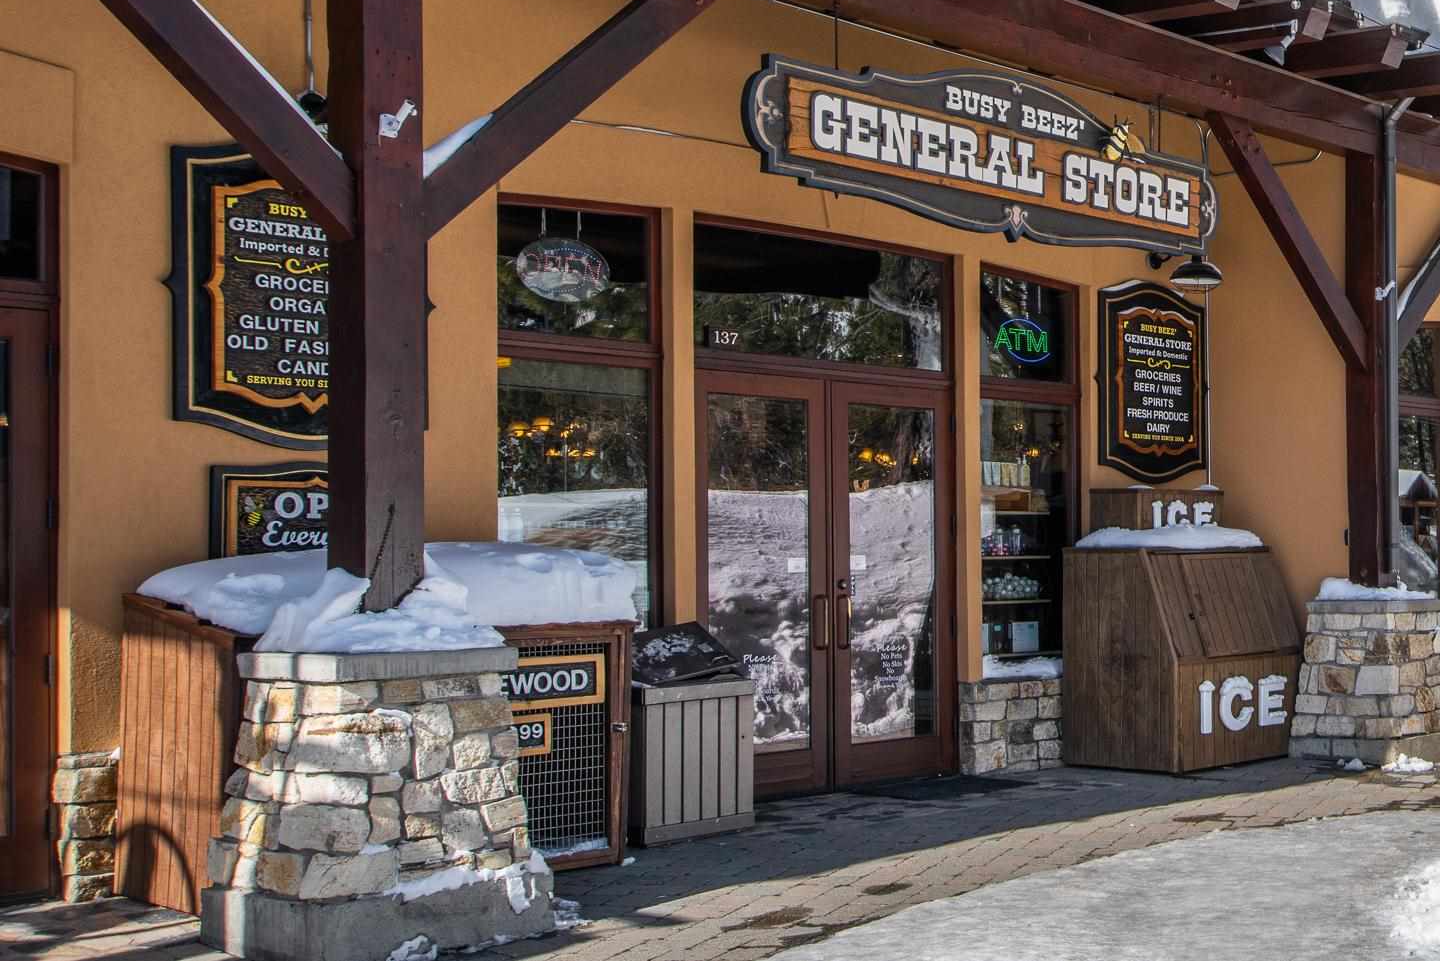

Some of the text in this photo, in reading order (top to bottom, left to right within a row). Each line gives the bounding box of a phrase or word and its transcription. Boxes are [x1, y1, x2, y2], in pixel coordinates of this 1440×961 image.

[945, 85, 1085, 141] BUSY BEEZ'
[811, 93, 1190, 226] GENERAL STORE
[268, 203, 308, 218] BUSY
[228, 217, 327, 242] GENERAL
[239, 238, 304, 255] Imported
[307, 246, 321, 257] &
[269, 296, 327, 315] ORGA
[239, 314, 320, 335] GLUTEN
[1140, 323, 1158, 334] BUSY
[226, 334, 269, 351] OLD
[714, 330, 739, 345] 137
[993, 327, 1048, 353] ATM
[1124, 333, 1192, 351] GENERAL STORE
[1128, 345, 1156, 356] Imported
[1162, 350, 1188, 361] Domestic
[246, 374, 292, 386] SERVING
[294, 377, 316, 388] YOU
[1135, 368, 1182, 383] GROCERIES
[1161, 384, 1182, 396] WINE
[1142, 396, 1174, 408] SPIRITS
[1127, 407, 1189, 423] FRESH PRODUCE
[1146, 422, 1170, 434] DAIRY
[1151, 500, 1218, 529] ICE
[743, 653, 778, 664] Please
[1199, 674, 1288, 735] ICE
